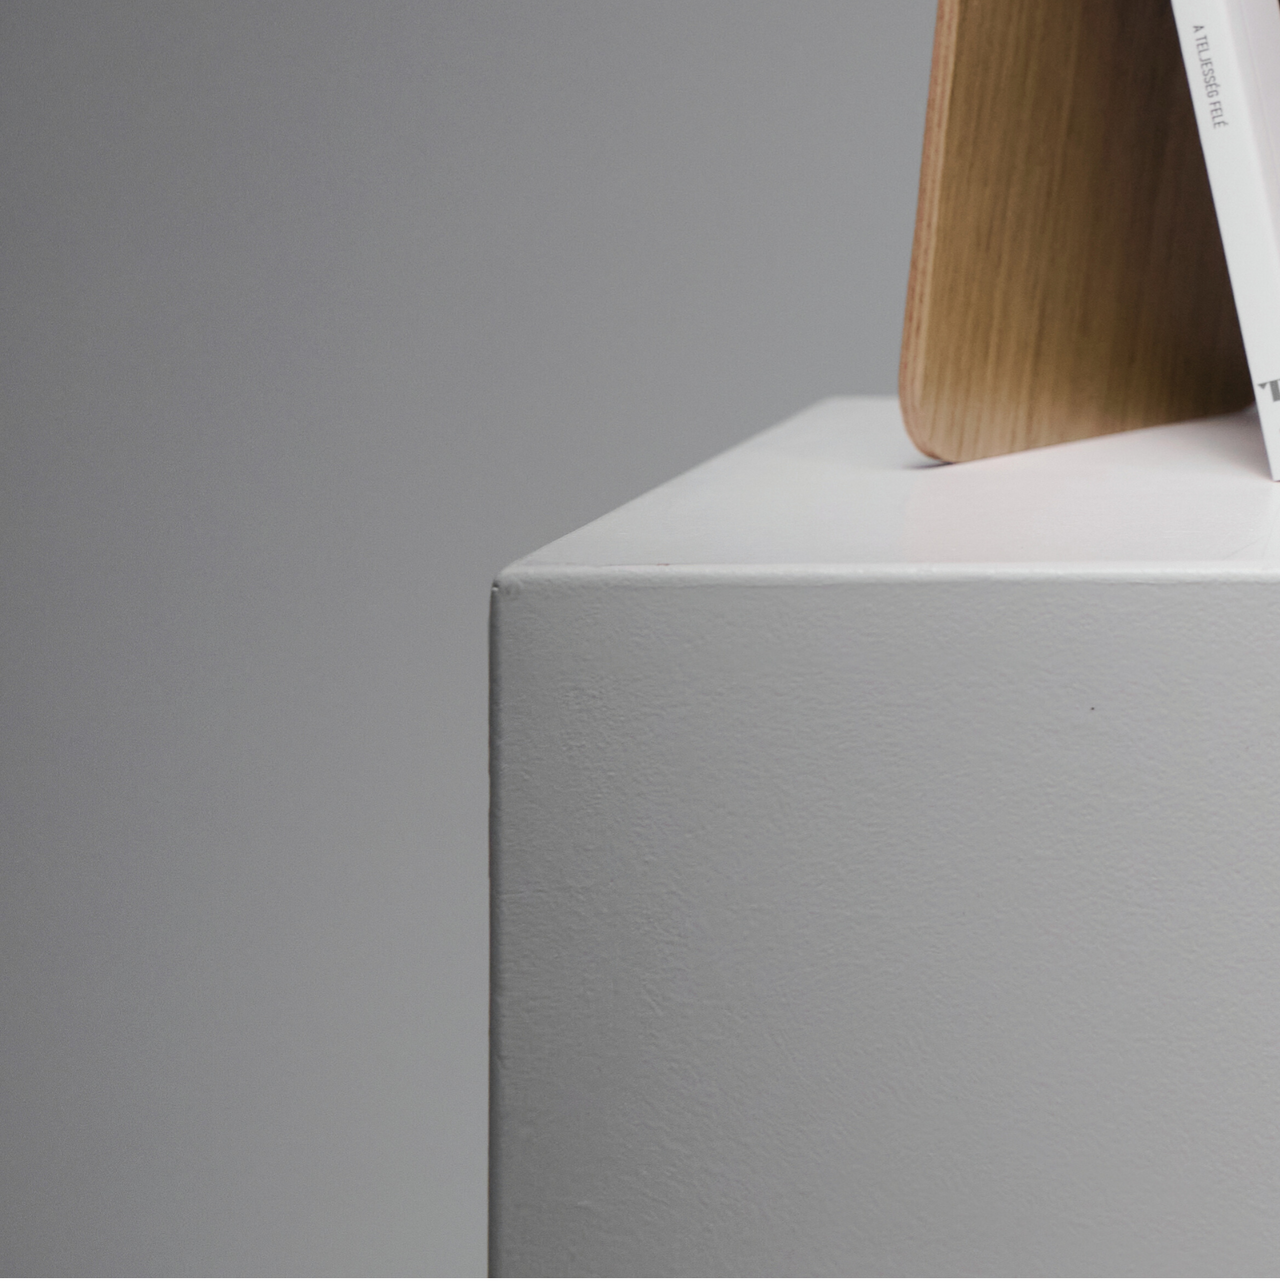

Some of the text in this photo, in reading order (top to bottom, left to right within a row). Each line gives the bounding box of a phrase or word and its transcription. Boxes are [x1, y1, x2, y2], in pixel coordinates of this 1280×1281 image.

[1192, 25, 1228, 130] A TELJESSÉG FELÉ
